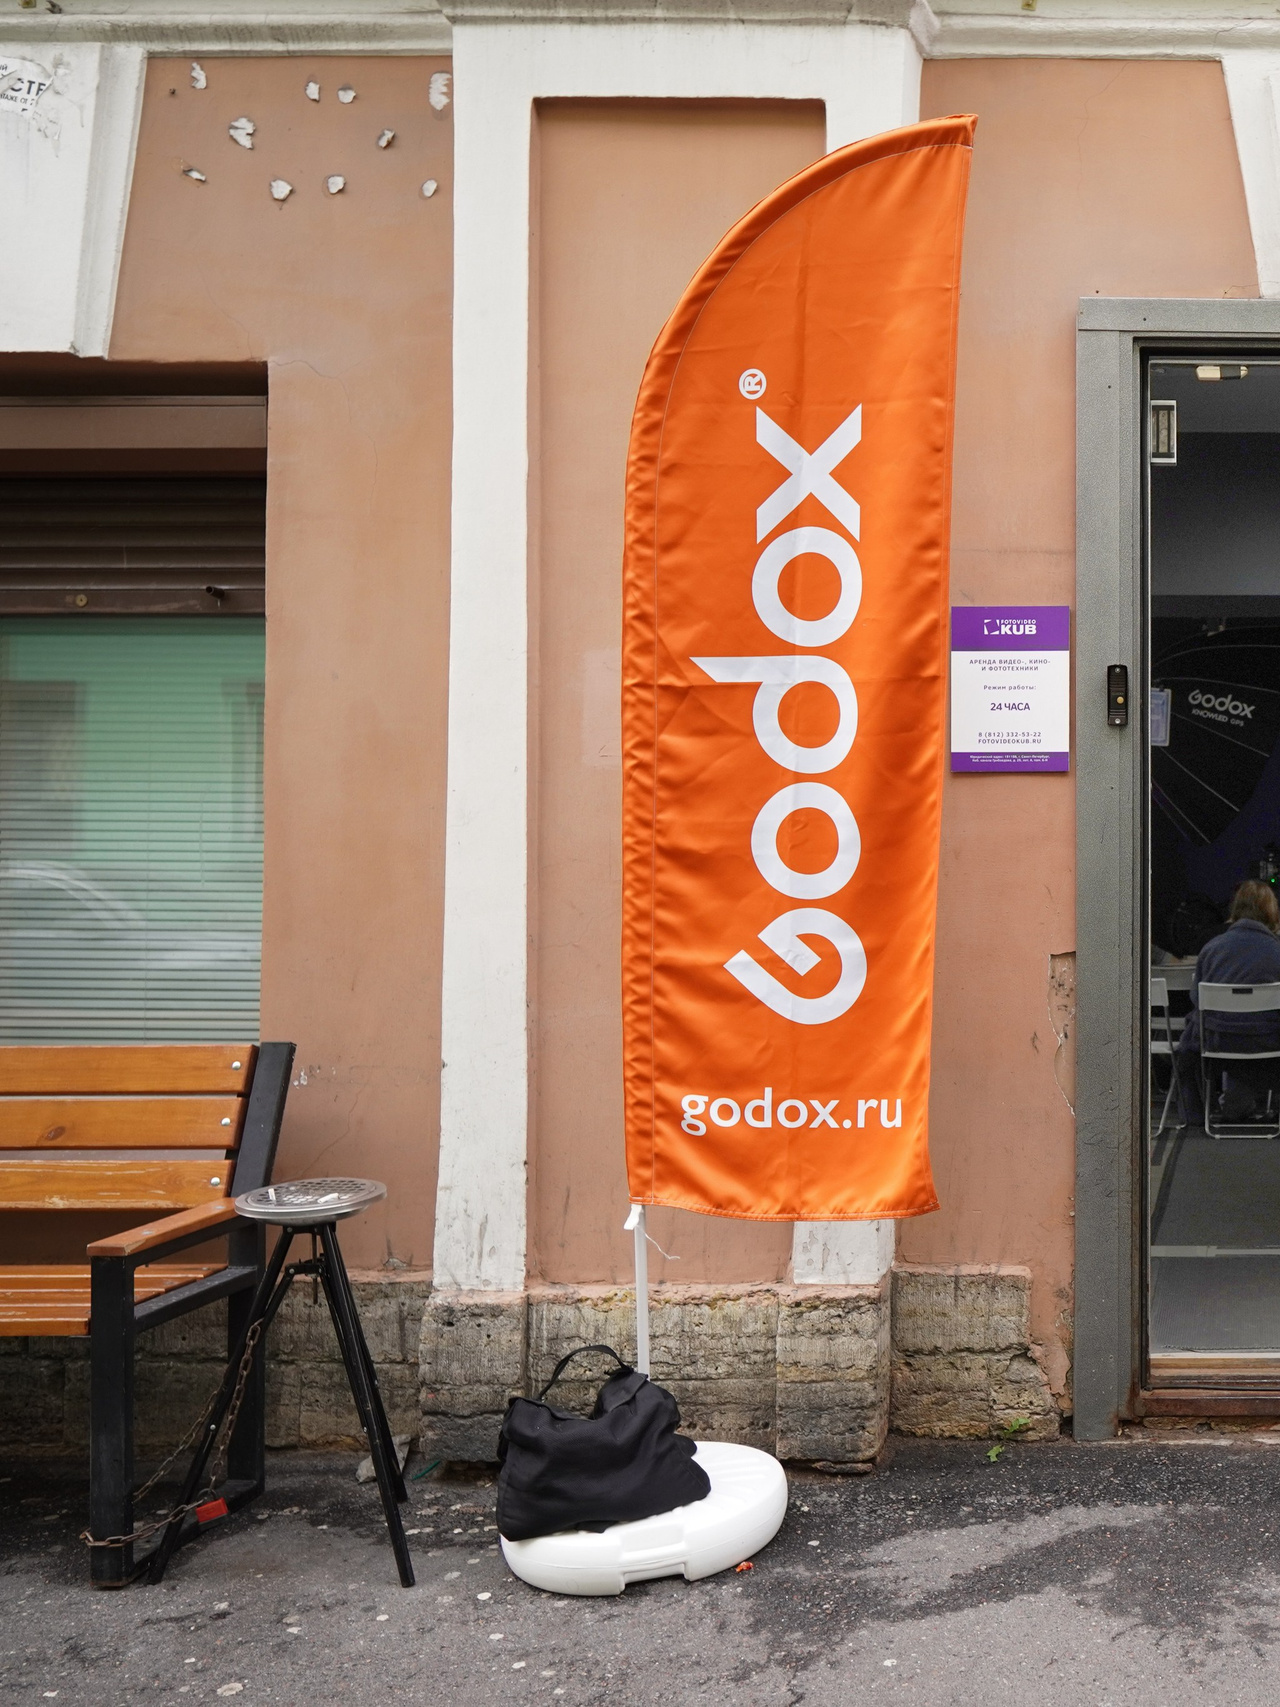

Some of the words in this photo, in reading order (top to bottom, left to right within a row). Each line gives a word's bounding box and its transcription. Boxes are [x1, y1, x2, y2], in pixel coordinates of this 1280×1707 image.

[1001, 625, 1037, 635] KUB
[990, 703, 1003, 711] 24
[1004, 703, 1031, 711] ЧАСА
[1188, 689, 1256, 719] Godox
[1191, 708, 1229, 723] KNOWLED
[680, 1087, 902, 1136] godox.ru
